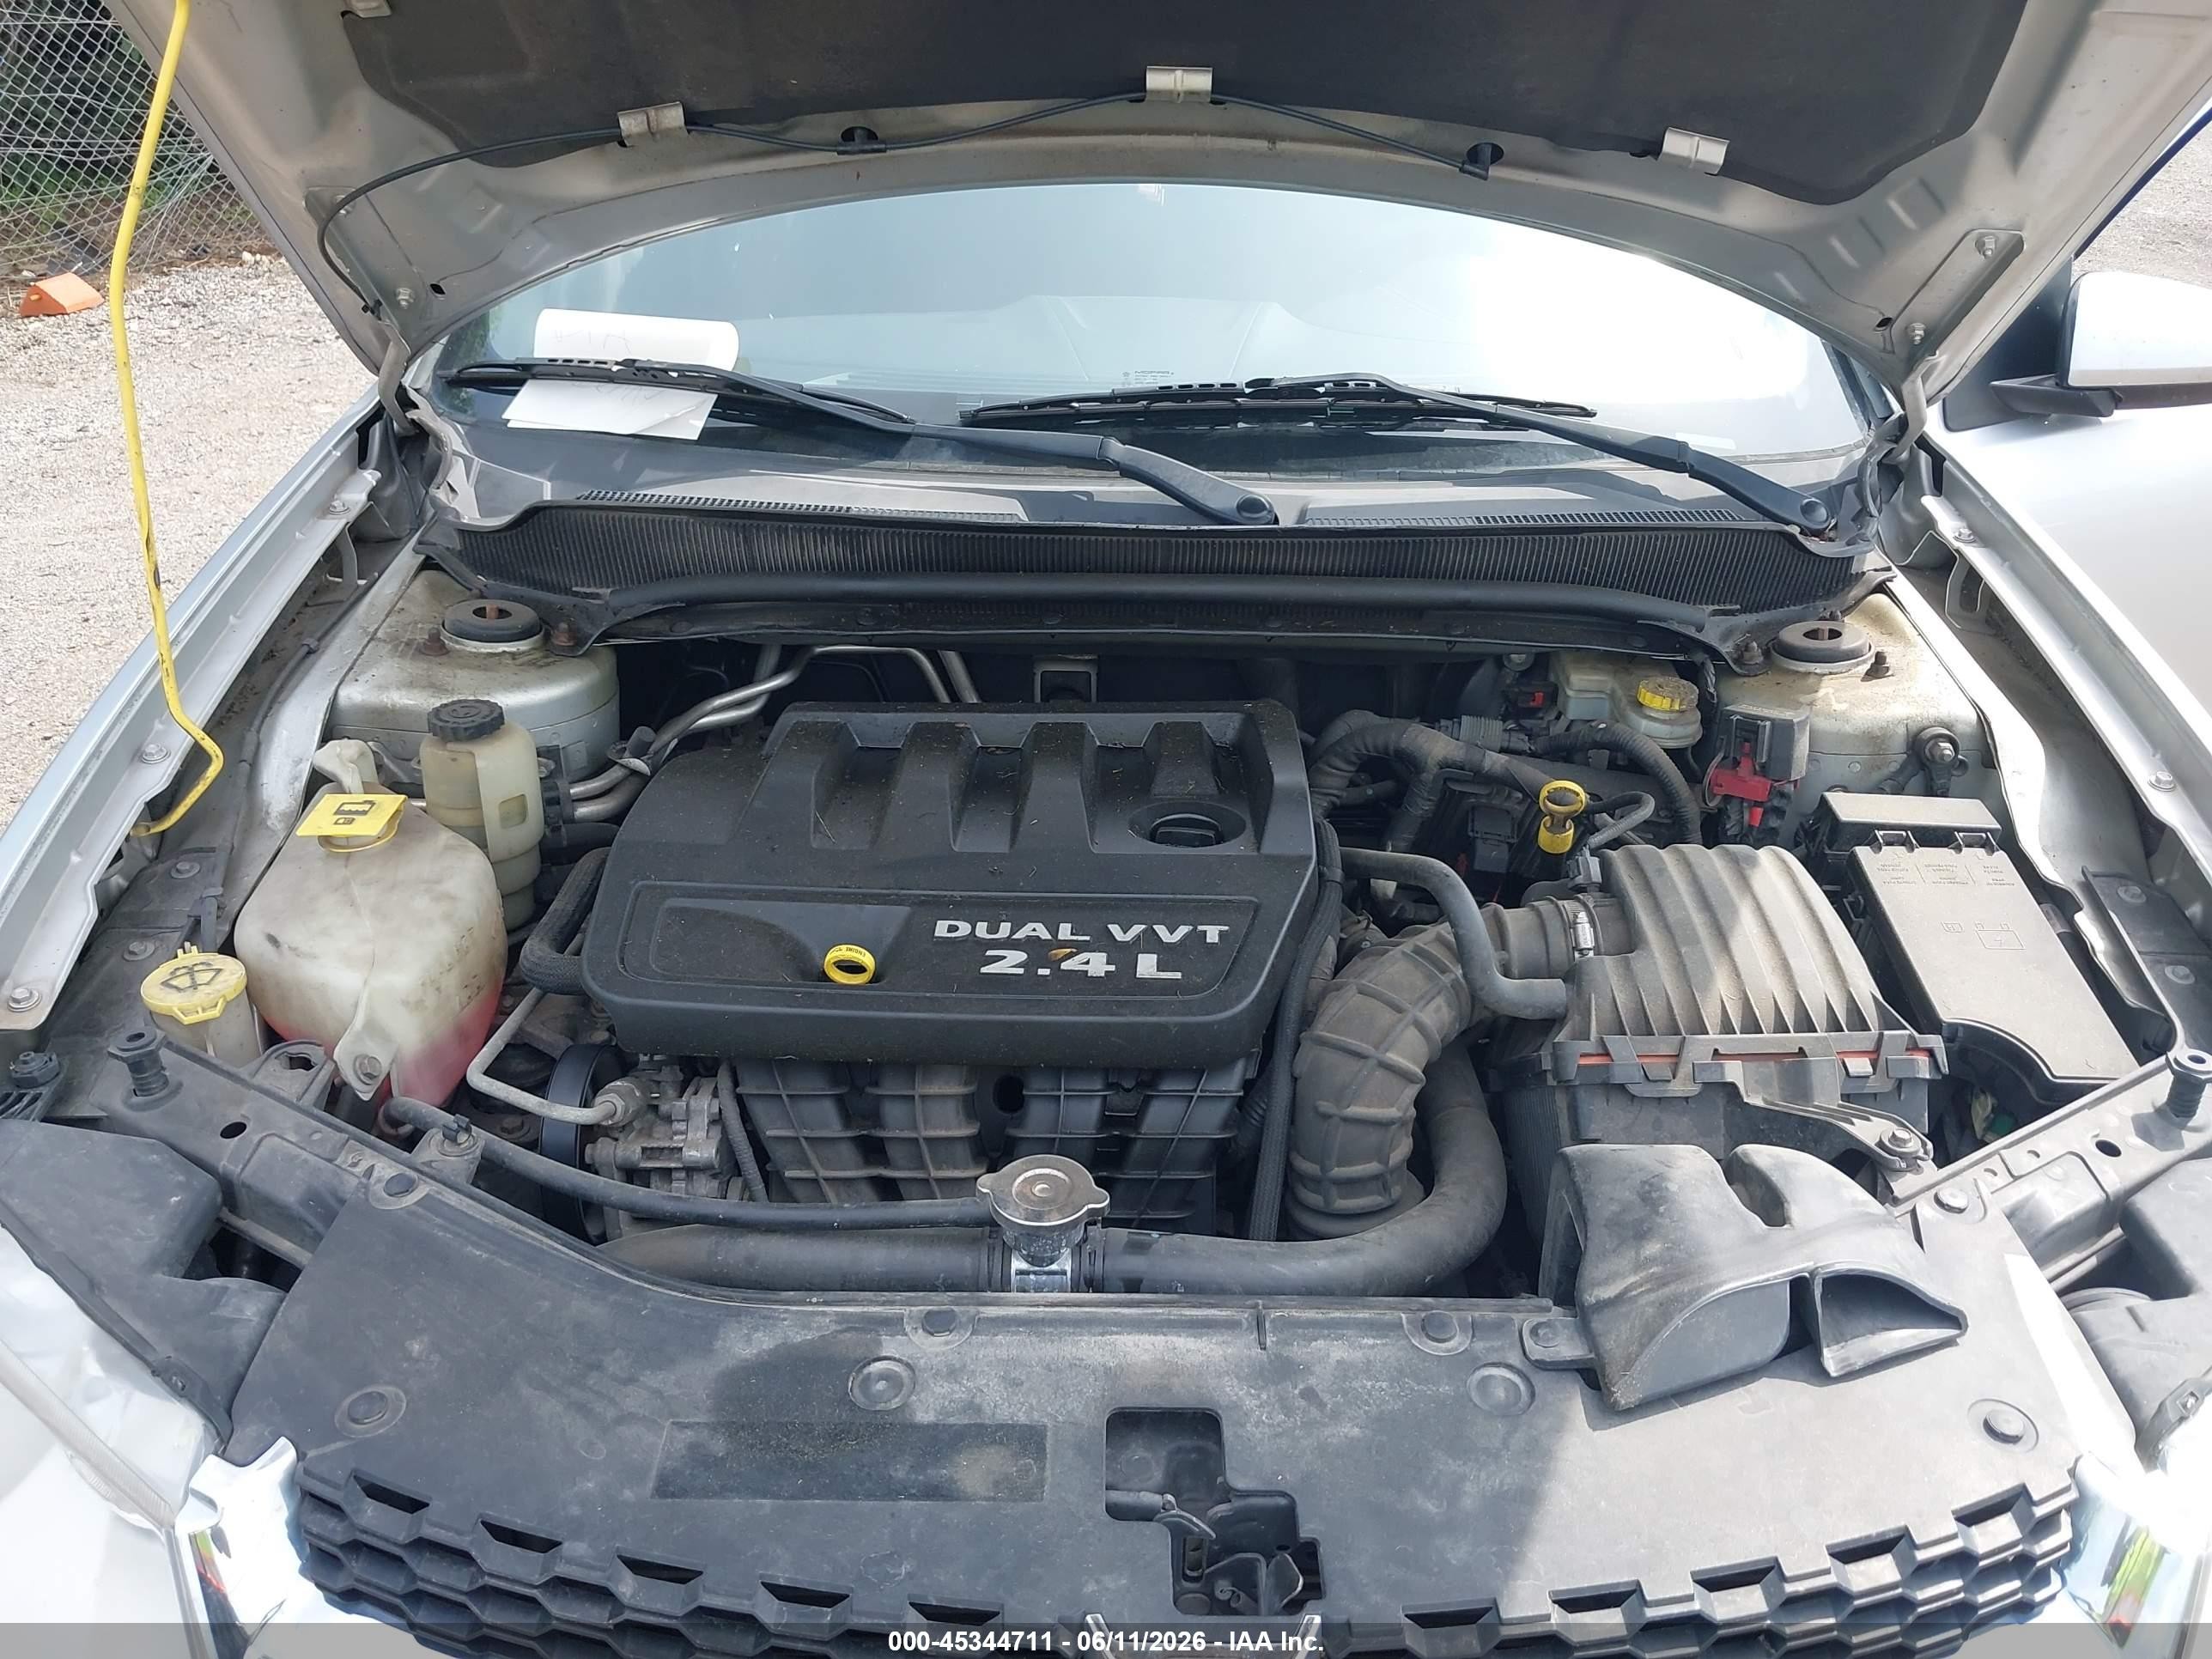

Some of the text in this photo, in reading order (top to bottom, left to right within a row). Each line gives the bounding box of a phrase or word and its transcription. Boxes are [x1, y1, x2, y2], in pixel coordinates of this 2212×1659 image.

[933, 920, 1230, 943] DUAL VVT
[980, 950, 1182, 979] 2.4 L
